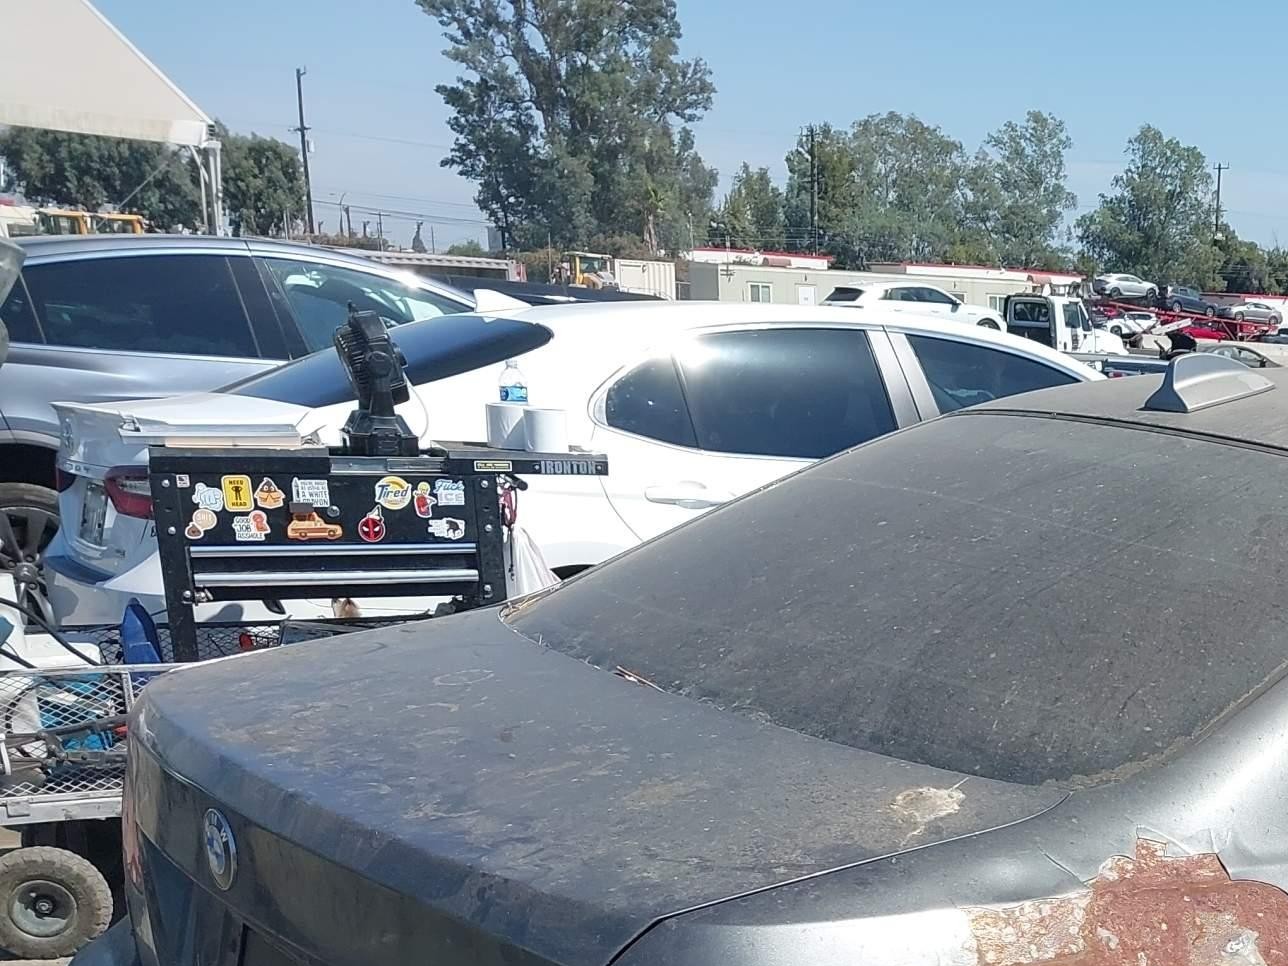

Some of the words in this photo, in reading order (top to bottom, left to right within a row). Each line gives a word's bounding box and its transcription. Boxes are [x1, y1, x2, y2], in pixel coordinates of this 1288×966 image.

[540, 460, 596, 474] IRONTON
[435, 480, 463, 492] Fuck
[377, 484, 410, 501] Tired
[439, 493, 463, 501] ICE
[236, 524, 252, 532] JOB
